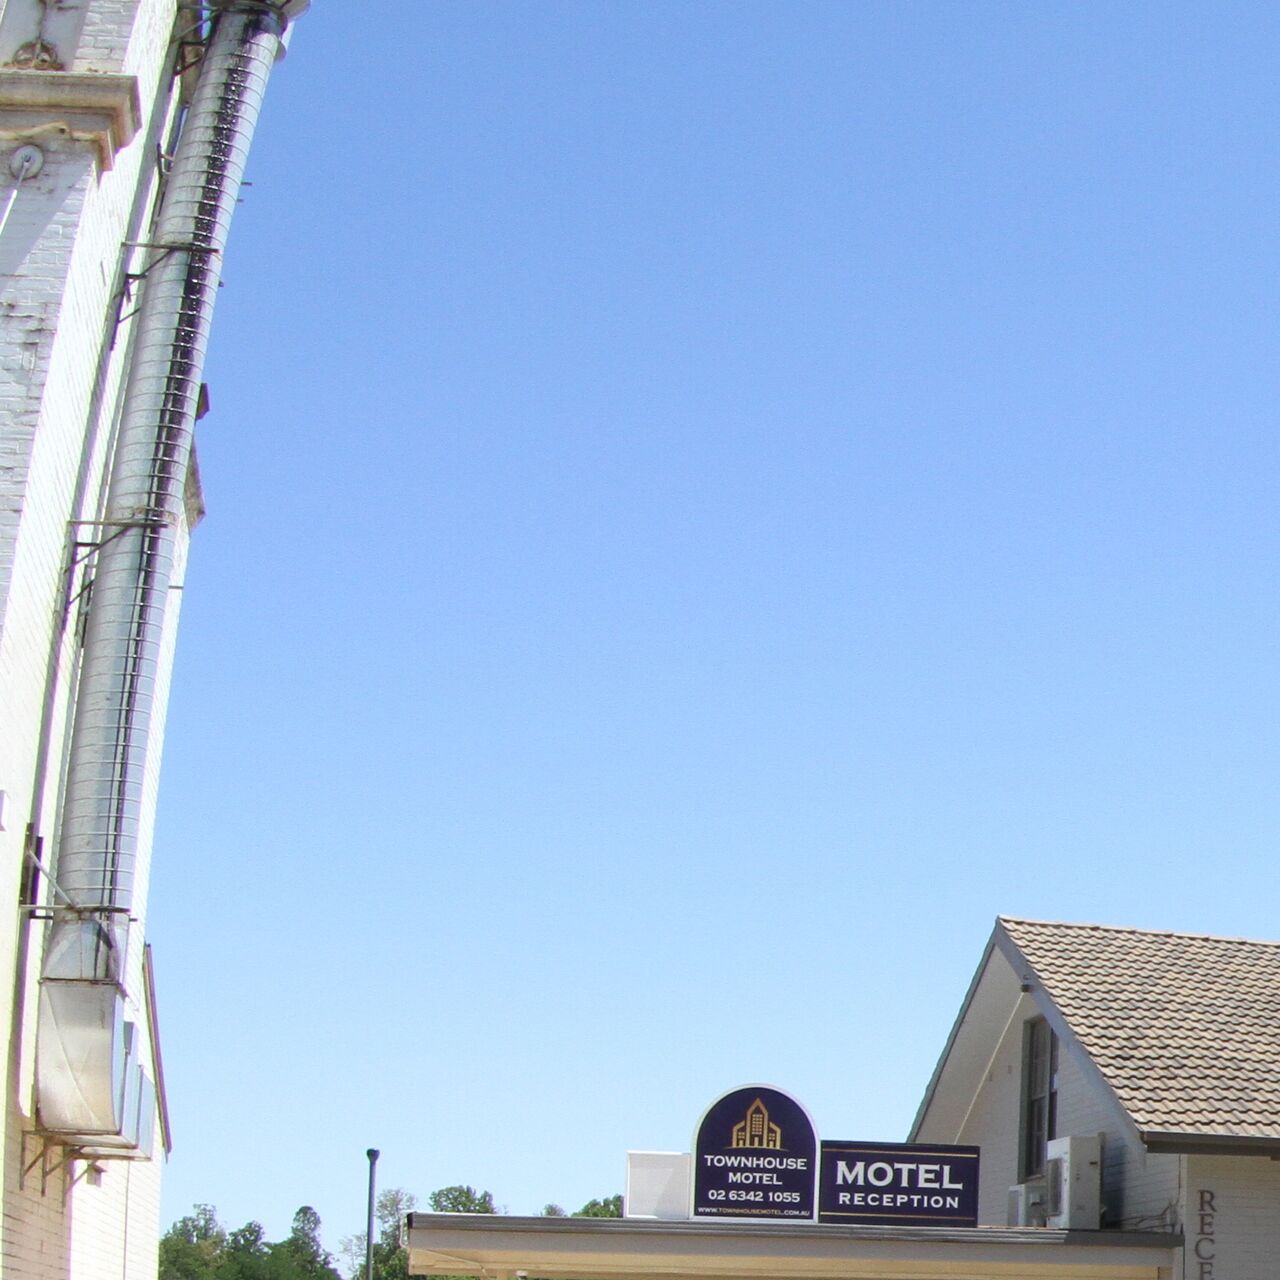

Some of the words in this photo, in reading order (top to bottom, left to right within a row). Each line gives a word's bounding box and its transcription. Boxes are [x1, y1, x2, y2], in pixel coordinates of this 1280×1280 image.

[703, 1154, 808, 1170] TOWNHOUSE
[728, 1172, 783, 1185] MOTEL
[835, 1160, 963, 1190] MOTEL
[708, 1189, 726, 1200] 02
[728, 1190, 763, 1201] 6342
[768, 1191, 800, 1203] 1055
[838, 1192, 959, 1209] RECEPTION
